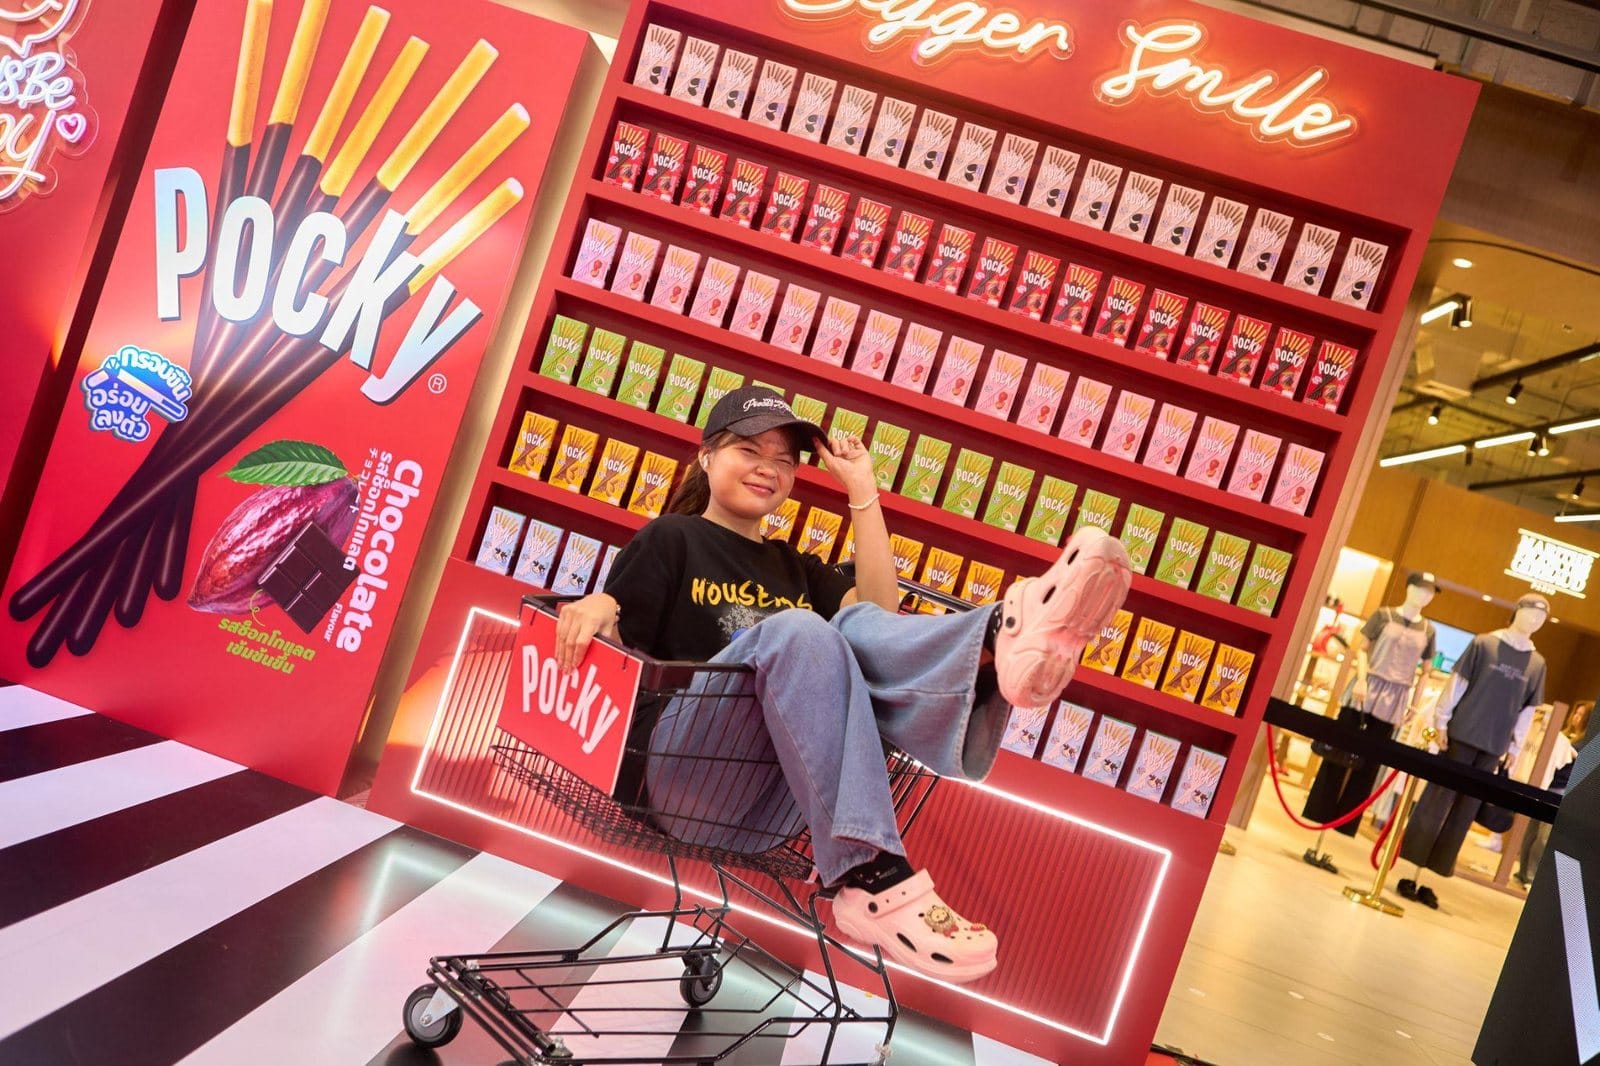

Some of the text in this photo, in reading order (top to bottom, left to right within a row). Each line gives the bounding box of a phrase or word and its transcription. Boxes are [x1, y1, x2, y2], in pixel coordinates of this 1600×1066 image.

[785, 0, 1352, 140] gger Smile
[614, 141, 640, 160] POCKY
[653, 153, 679, 172] POCKY
[692, 166, 718, 184] POCKY
[732, 178, 758, 197] POCKY
[773, 192, 799, 210] POCKY
[814, 204, 840, 223] POCKY
[855, 218, 881, 236] POCKY
[897, 231, 924, 250] POCKY
[939, 244, 966, 263] POCKY
[982, 258, 1008, 276] POCKY
[154, 167, 482, 403] POCKY
[1023, 271, 1050, 290] POCKY
[1064, 284, 1091, 302] POCKY
[1108, 296, 1135, 315] POCKY
[1150, 310, 1177, 329] POCKY
[1192, 323, 1219, 342] POCKY
[552, 334, 579, 353] POCKY
[1234, 336, 1260, 354] POCKY
[590, 347, 617, 366] POCKY
[1276, 348, 1303, 367] POCKY
[630, 360, 656, 379] POCKY
[1320, 362, 1346, 381] POCKY
[670, 373, 696, 392] POCKY
[91, 382, 149, 415] อร่อย
[96, 409, 148, 438] ลงตัว
[874, 441, 900, 460] POCKY
[915, 454, 942, 473] POCKY
[956, 469, 984, 488] POCKY
[998, 482, 1025, 501] POCKY
[1040, 496, 1068, 515] POCKY
[1084, 509, 1110, 528] POCKY
[1128, 524, 1154, 543] POCKY
[336, 459, 424, 653] Chocolate
[1171, 539, 1198, 558] POCKY
[1212, 552, 1240, 571] POCKY
[1254, 566, 1281, 585] POCKY
[522, 644, 620, 755] POCKY
